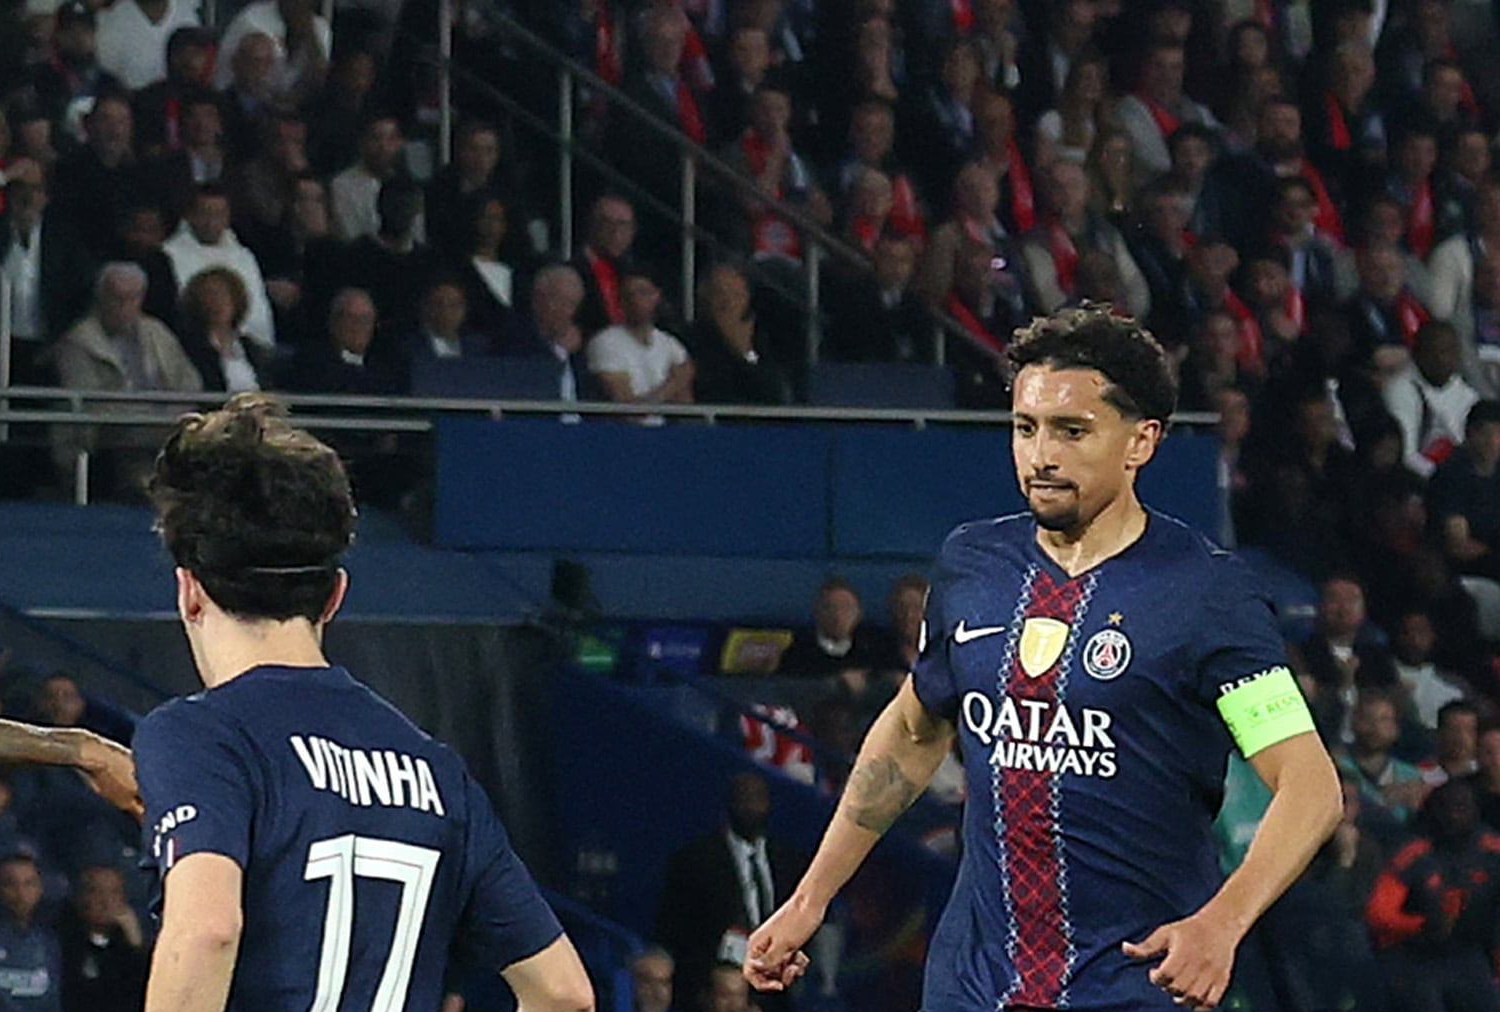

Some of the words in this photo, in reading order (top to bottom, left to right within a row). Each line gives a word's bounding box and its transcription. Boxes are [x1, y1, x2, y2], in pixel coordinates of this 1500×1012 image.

[962, 691, 1115, 749] QATAR
[290, 735, 445, 817] VITINHA
[988, 740, 1118, 777] AIRWAYS
